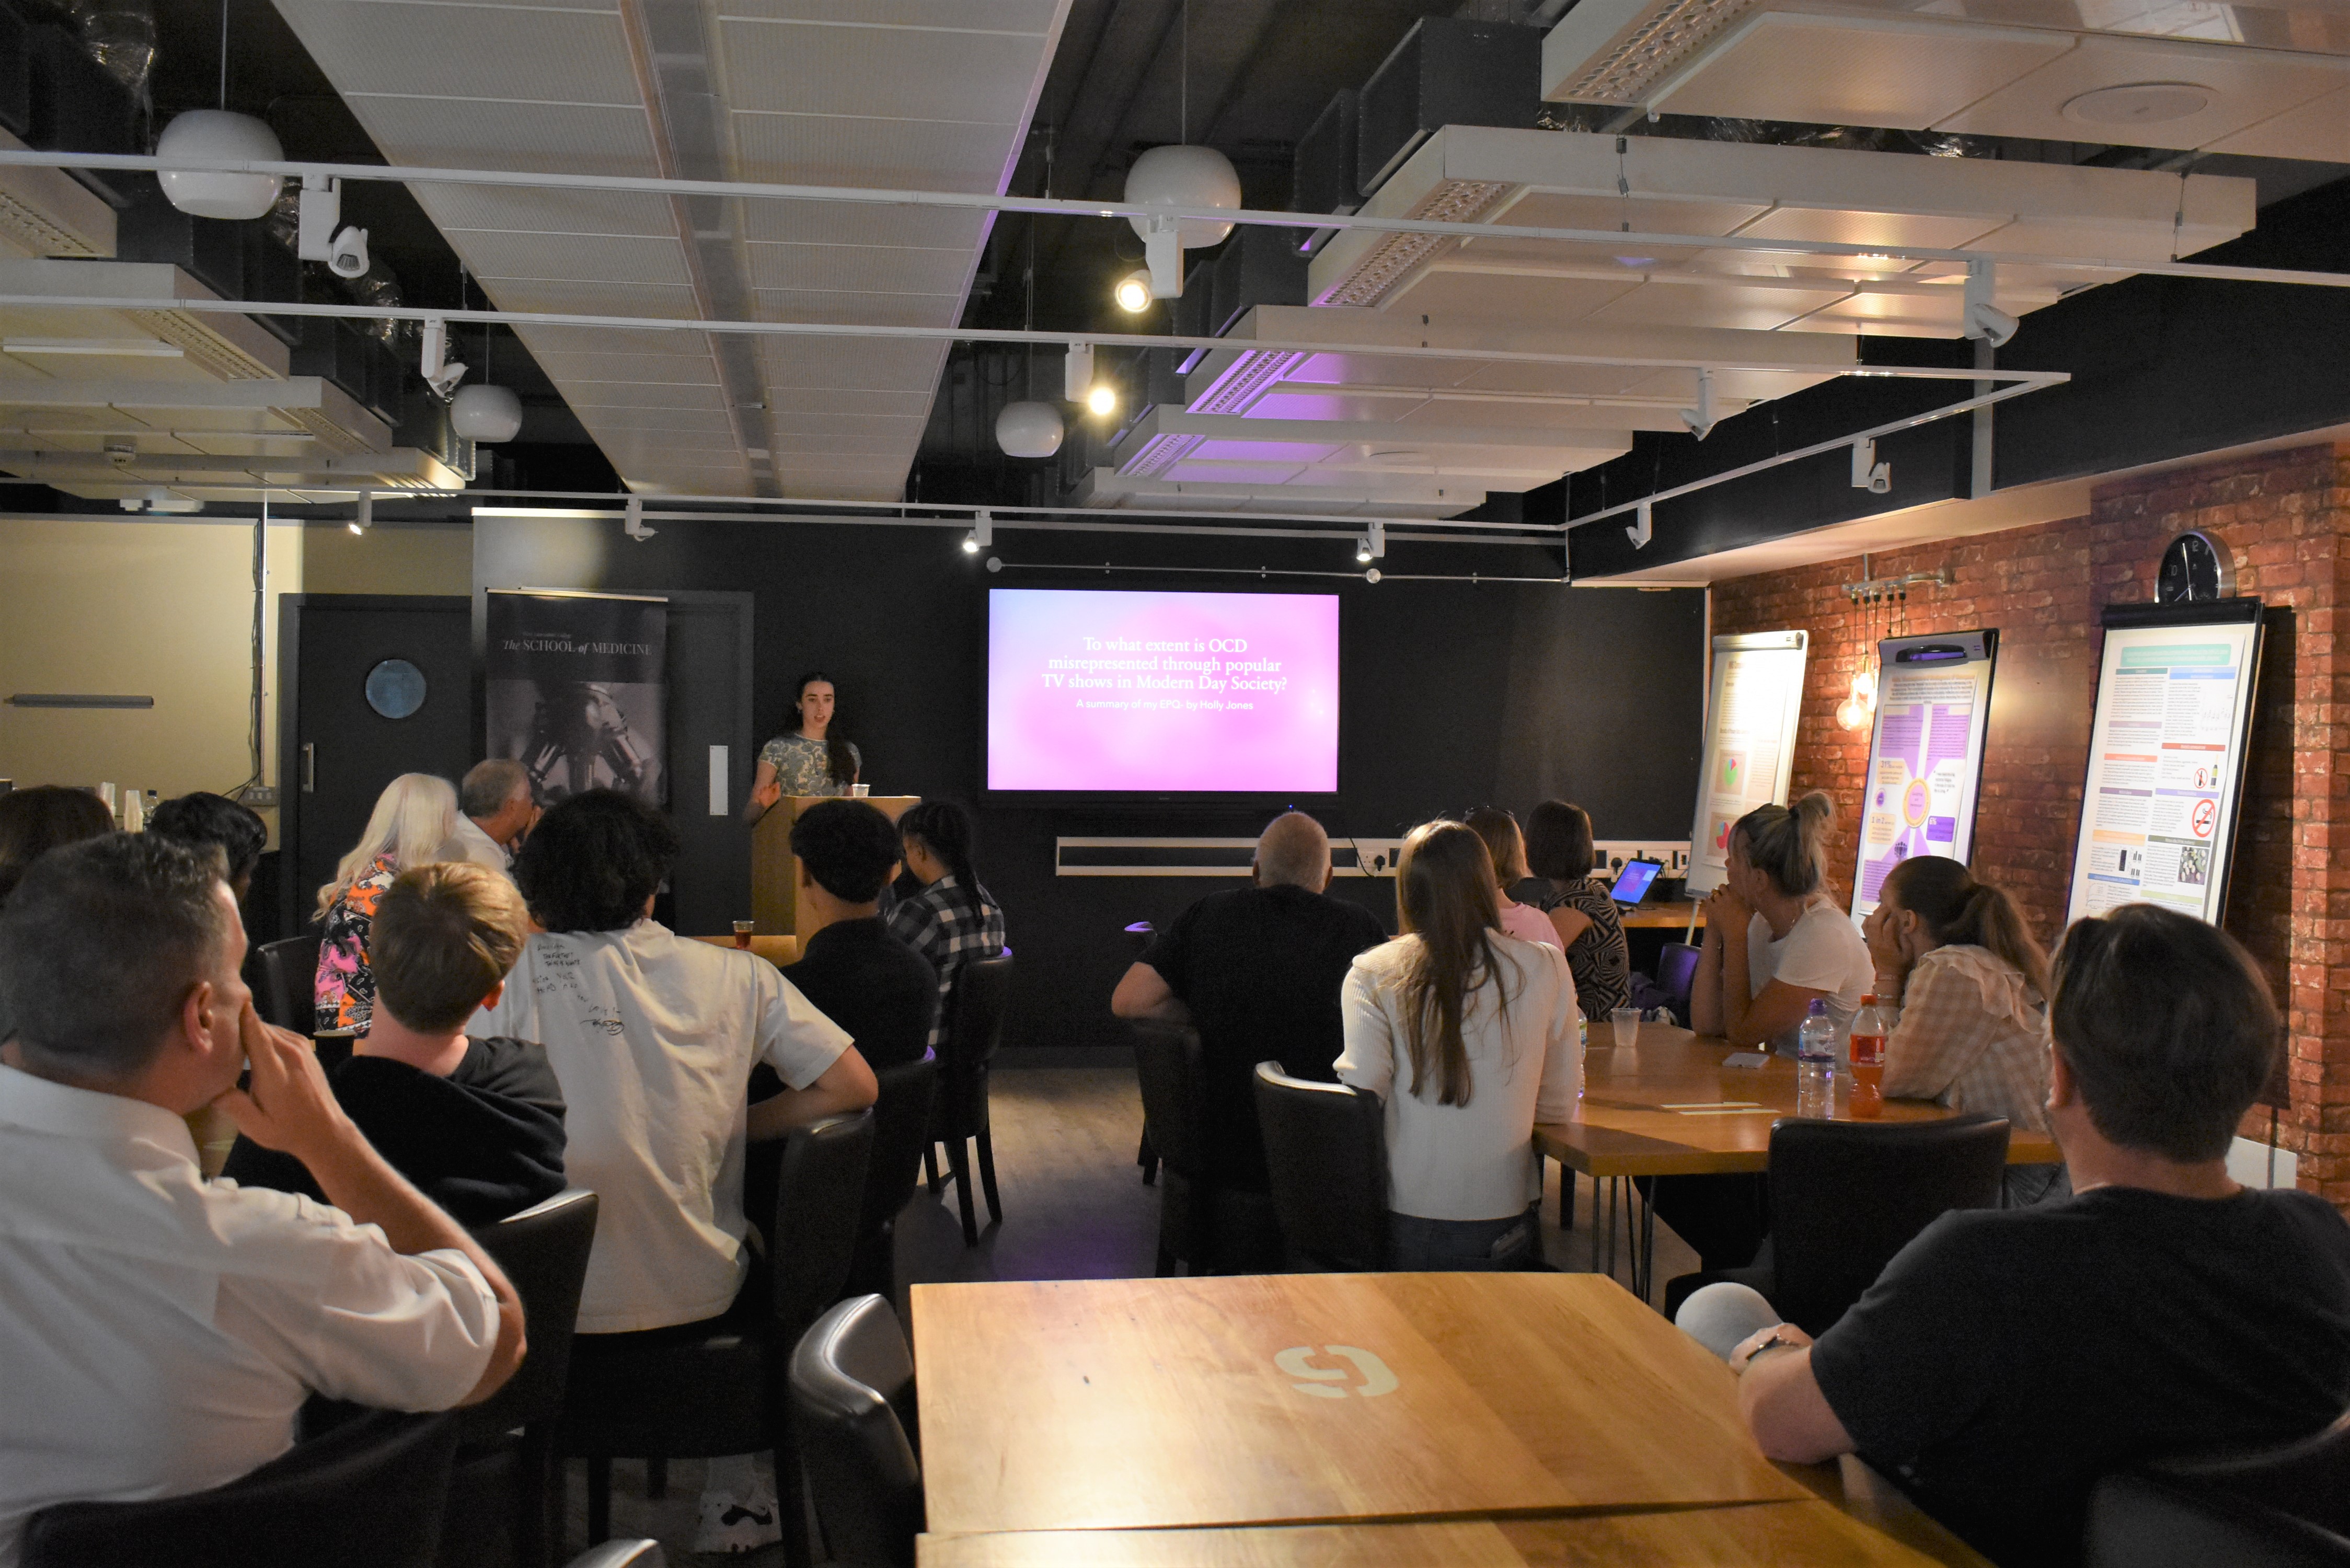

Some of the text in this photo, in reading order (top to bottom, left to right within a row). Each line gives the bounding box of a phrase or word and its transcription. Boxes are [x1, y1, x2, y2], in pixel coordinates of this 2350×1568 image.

[503, 639, 652, 656] The SCHOOL of MEDICINE
[1083, 636, 1248, 652] To what extent is OCD
[1048, 654, 1282, 675] misrepresented through popular
[1041, 673, 1287, 695] TV shows in Modern Day Society?
[1076, 698, 1084, 708] A
[1086, 700, 1129, 711] summary
[1131, 698, 1142, 708] of
[1143, 701, 1158, 711] my
[1186, 699, 1198, 711] by
[1200, 699, 1224, 712] Holly
[1226, 700, 1253, 710] Jones
